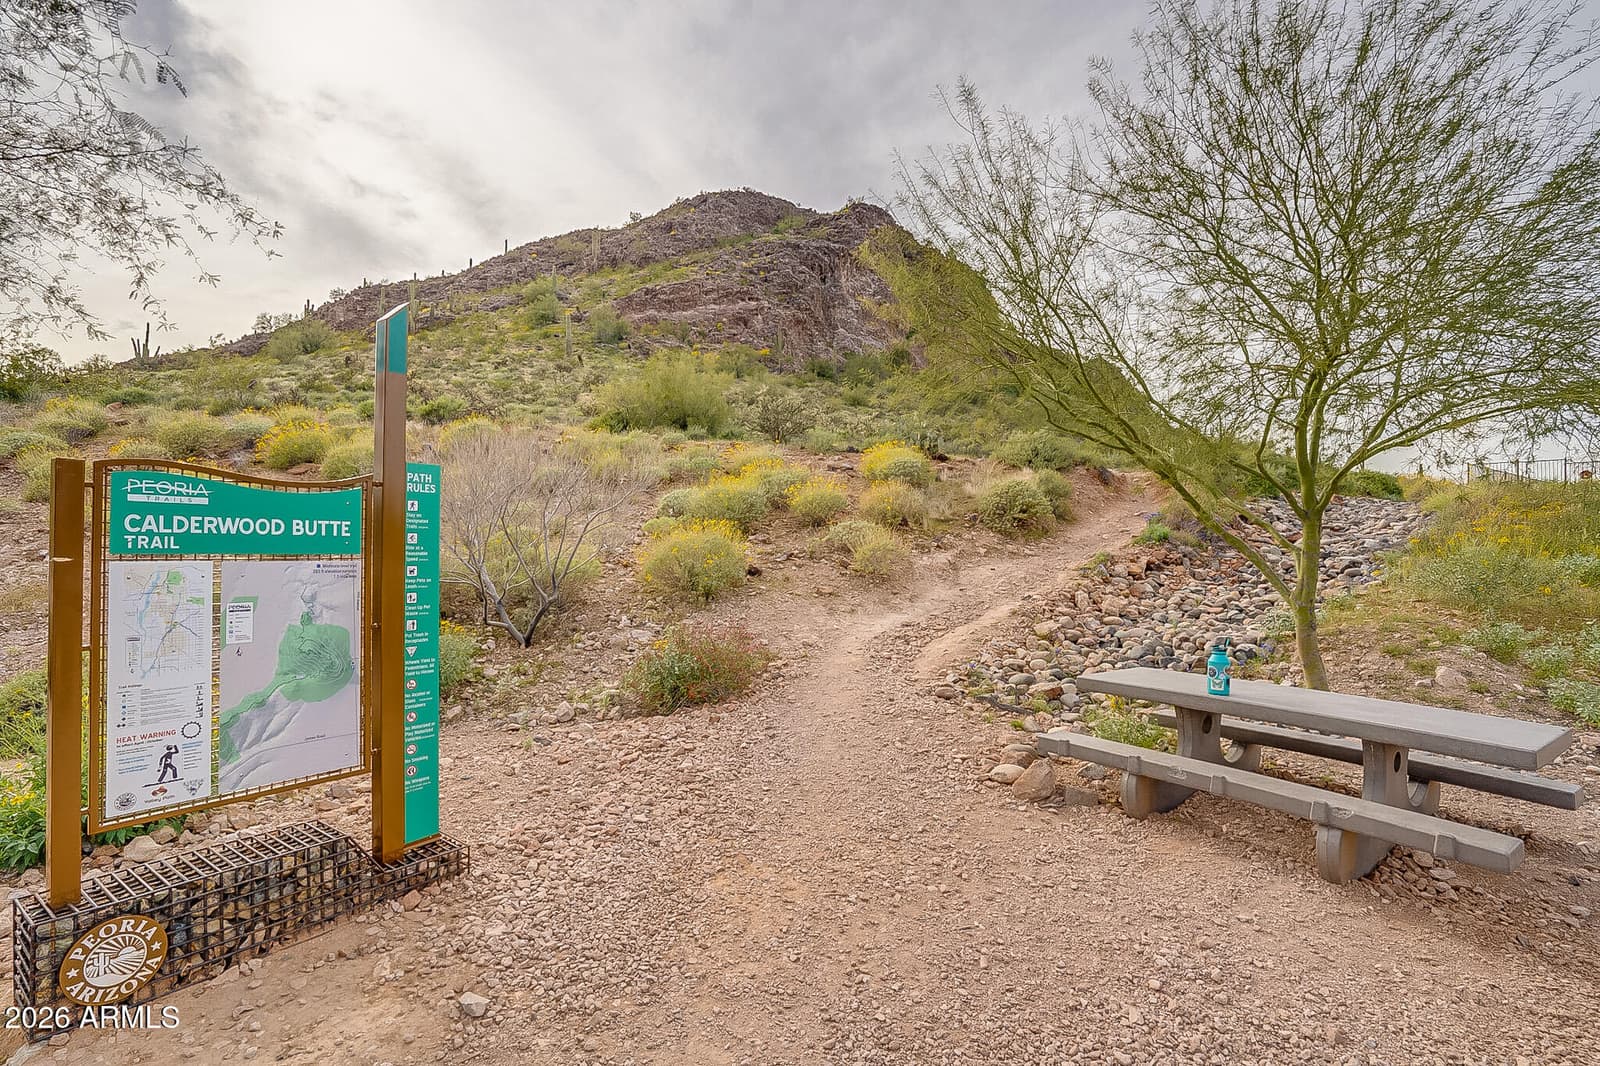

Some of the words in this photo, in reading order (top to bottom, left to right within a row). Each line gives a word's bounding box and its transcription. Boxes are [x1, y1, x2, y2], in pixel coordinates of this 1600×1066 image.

[407, 473, 432, 483] PATH
[127, 478, 209, 496] PEORIA
[407, 483, 436, 493] RULES
[124, 513, 285, 536] CALDERWOOD
[292, 519, 350, 537] BUTTE
[124, 535, 180, 549] TRAIL
[116, 736, 136, 744] HEAT
[140, 730, 176, 740] WARNING
[70, 918, 158, 961] PEORIA
[66, 956, 162, 1003] ARIZONA
